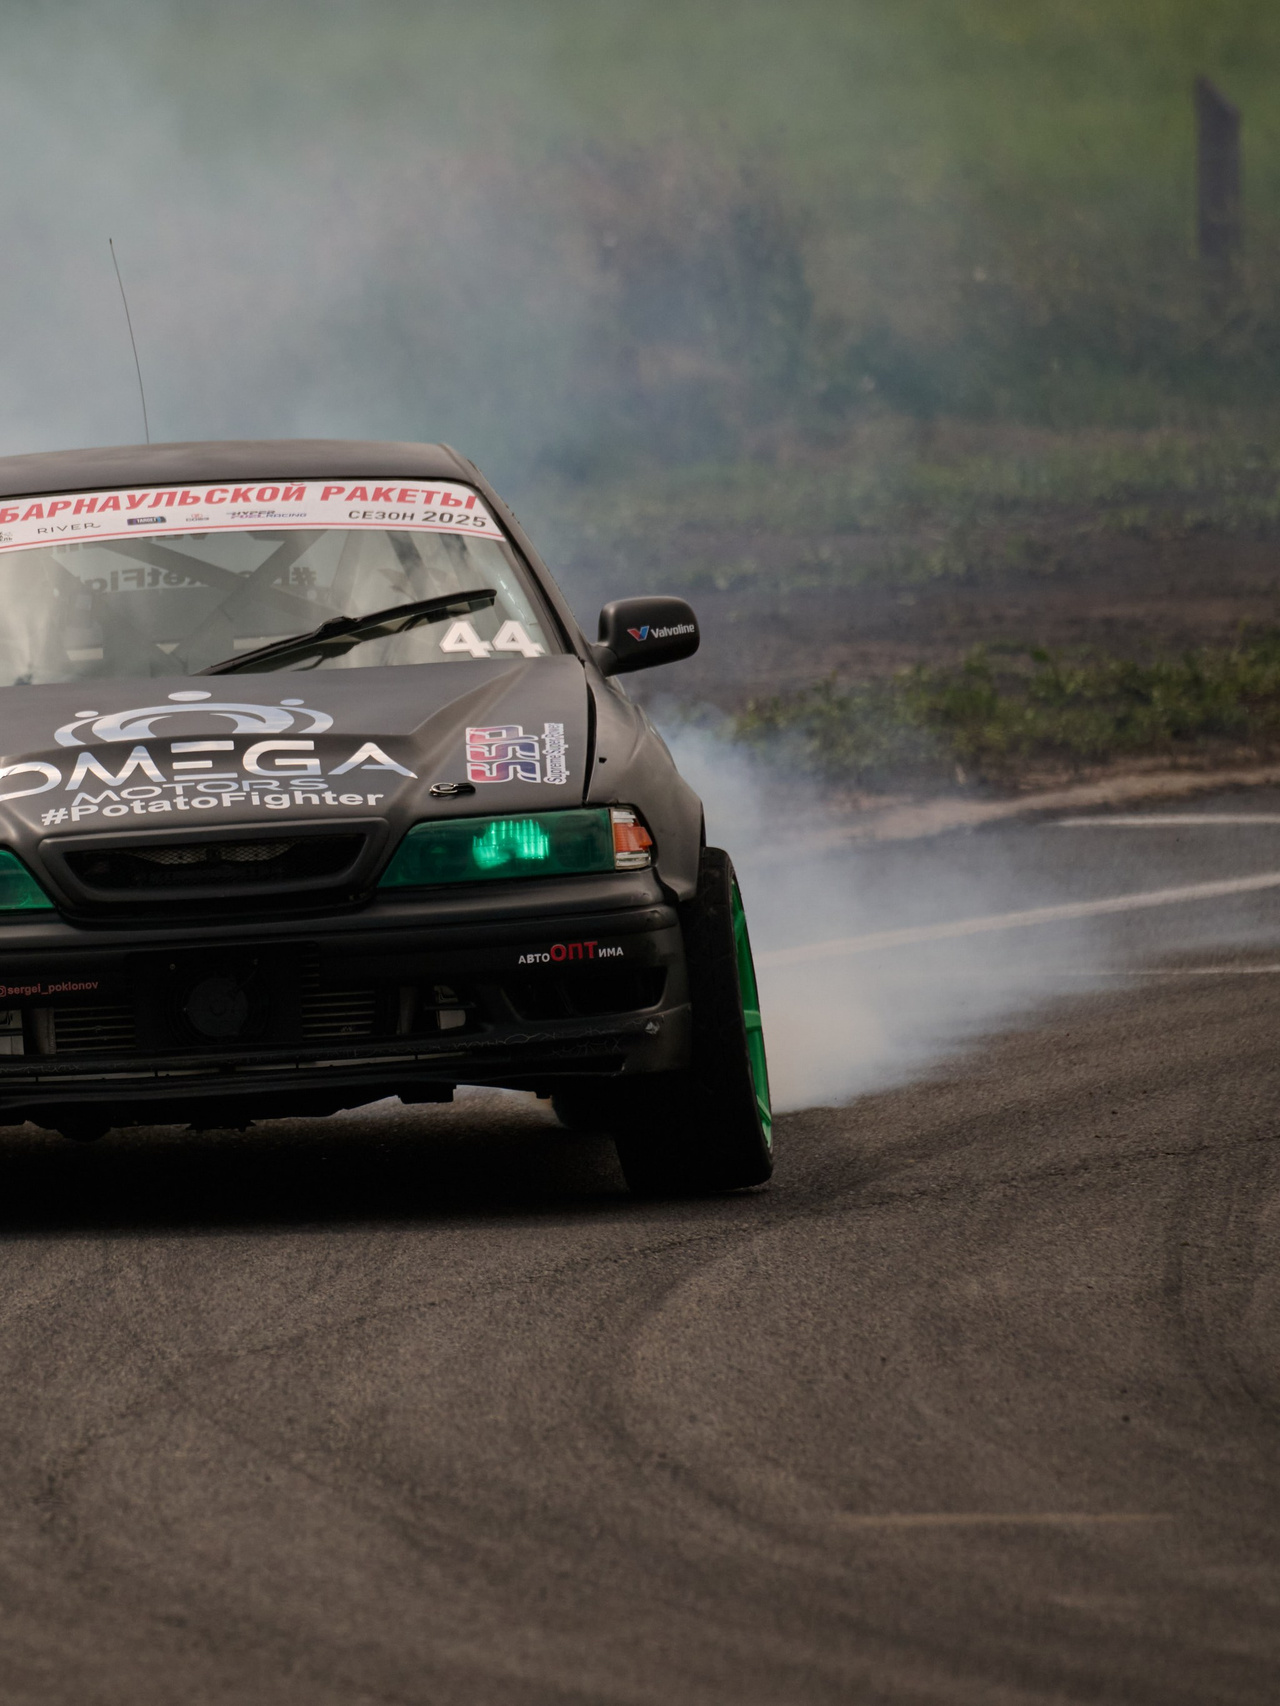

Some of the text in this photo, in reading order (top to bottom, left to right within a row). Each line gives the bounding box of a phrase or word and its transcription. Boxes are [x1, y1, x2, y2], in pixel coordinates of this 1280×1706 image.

[320, 485, 478, 511] РАКЕТЫ
[37, 522, 101, 534] RIVER
[348, 510, 487, 528] СЕЗОН 2025
[439, 620, 546, 658] 44
[651, 623, 695, 639] Valvoline
[72, 777, 330, 806] MOTORS
[41, 790, 384, 826] #PotatoFighter
